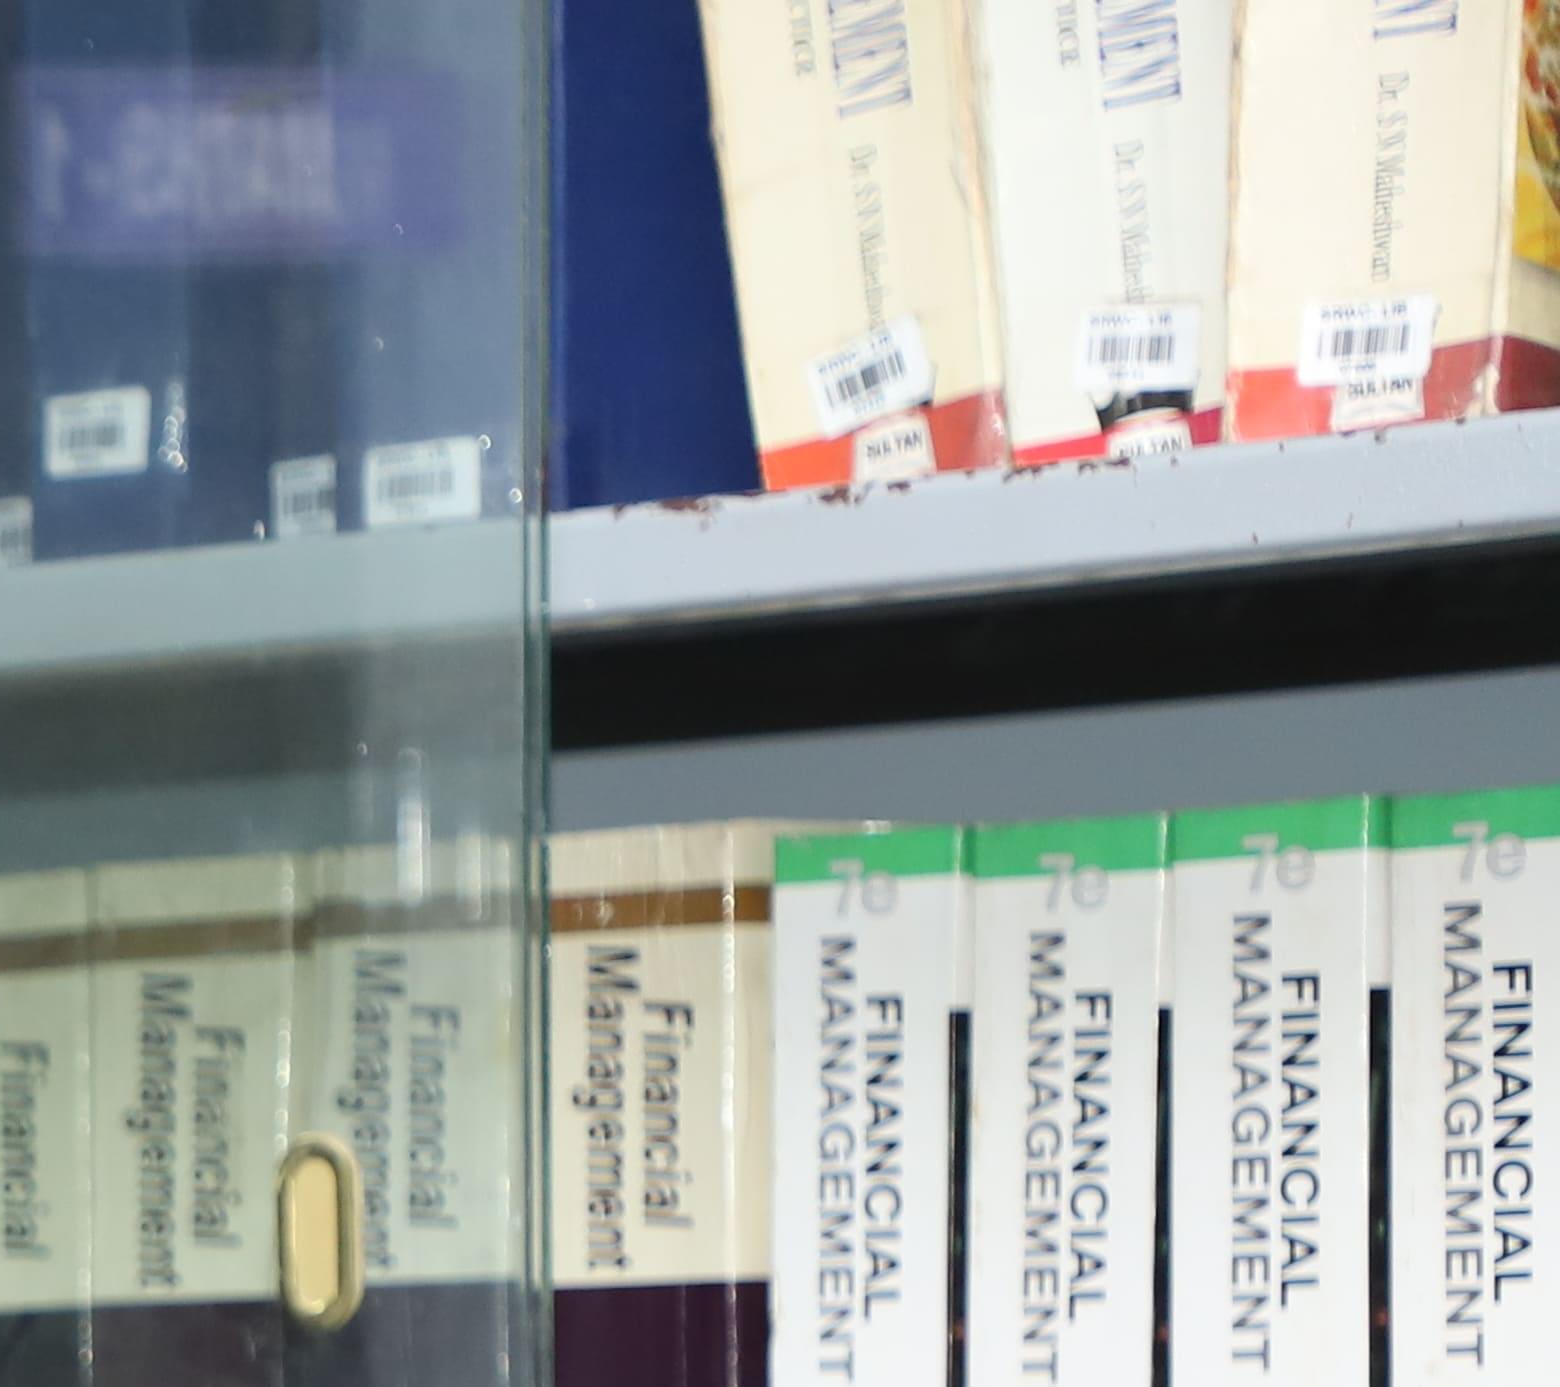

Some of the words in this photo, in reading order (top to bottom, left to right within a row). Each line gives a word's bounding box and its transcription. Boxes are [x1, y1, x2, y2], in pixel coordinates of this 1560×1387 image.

[828, 857, 898, 915] 7e
[1039, 853, 1110, 912] 7e
[1242, 832, 1315, 894] 7e
[1453, 822, 1526, 883] 7e
[0, 1041, 52, 1258] Financial
[126, 973, 194, 1287] Management
[193, 1026, 246, 1248] Financial
[410, 1006, 461, 1229] Financial
[573, 945, 642, 1270] Management
[642, 1000, 694, 1229] Financial
[819, 935, 857, 1383] MANAGEMENT
[864, 993, 904, 1318] FINANCIAL
[1021, 931, 1066, 1385] MANAGEMENT
[1070, 991, 1113, 1321] FINANCIAL
[1231, 913, 1271, 1372] MANAGEMENT
[1280, 972, 1320, 1309] FINANCIAL
[1443, 901, 1484, 1368] MANAGEMENT
[1492, 960, 1533, 1303] FINANCIAL
